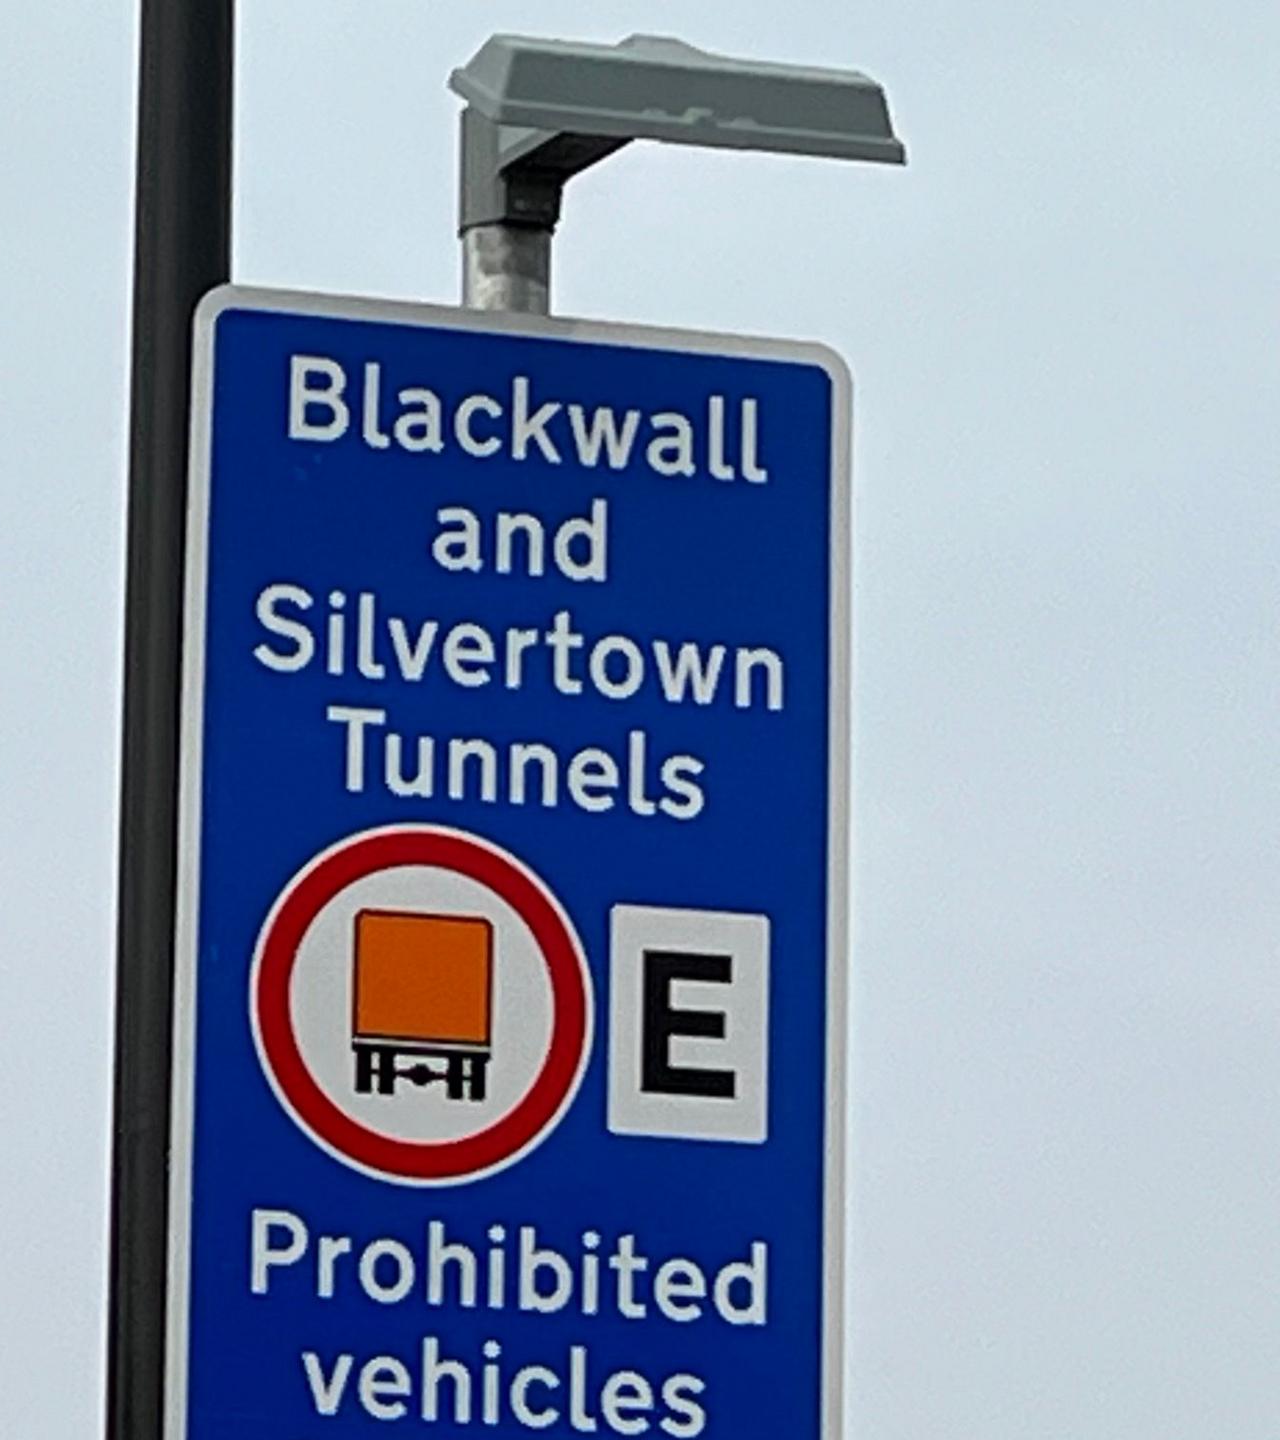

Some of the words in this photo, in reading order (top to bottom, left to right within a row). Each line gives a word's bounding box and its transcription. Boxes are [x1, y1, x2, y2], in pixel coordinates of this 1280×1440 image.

[288, 354, 768, 483] Blackwall
[432, 498, 608, 582] and
[253, 584, 783, 711] Silvertown
[327, 705, 705, 820] Tunnels
[640, 949, 737, 1099] E
[250, 1208, 768, 1325] Prohibited
[302, 1337, 708, 1439] vehicles
